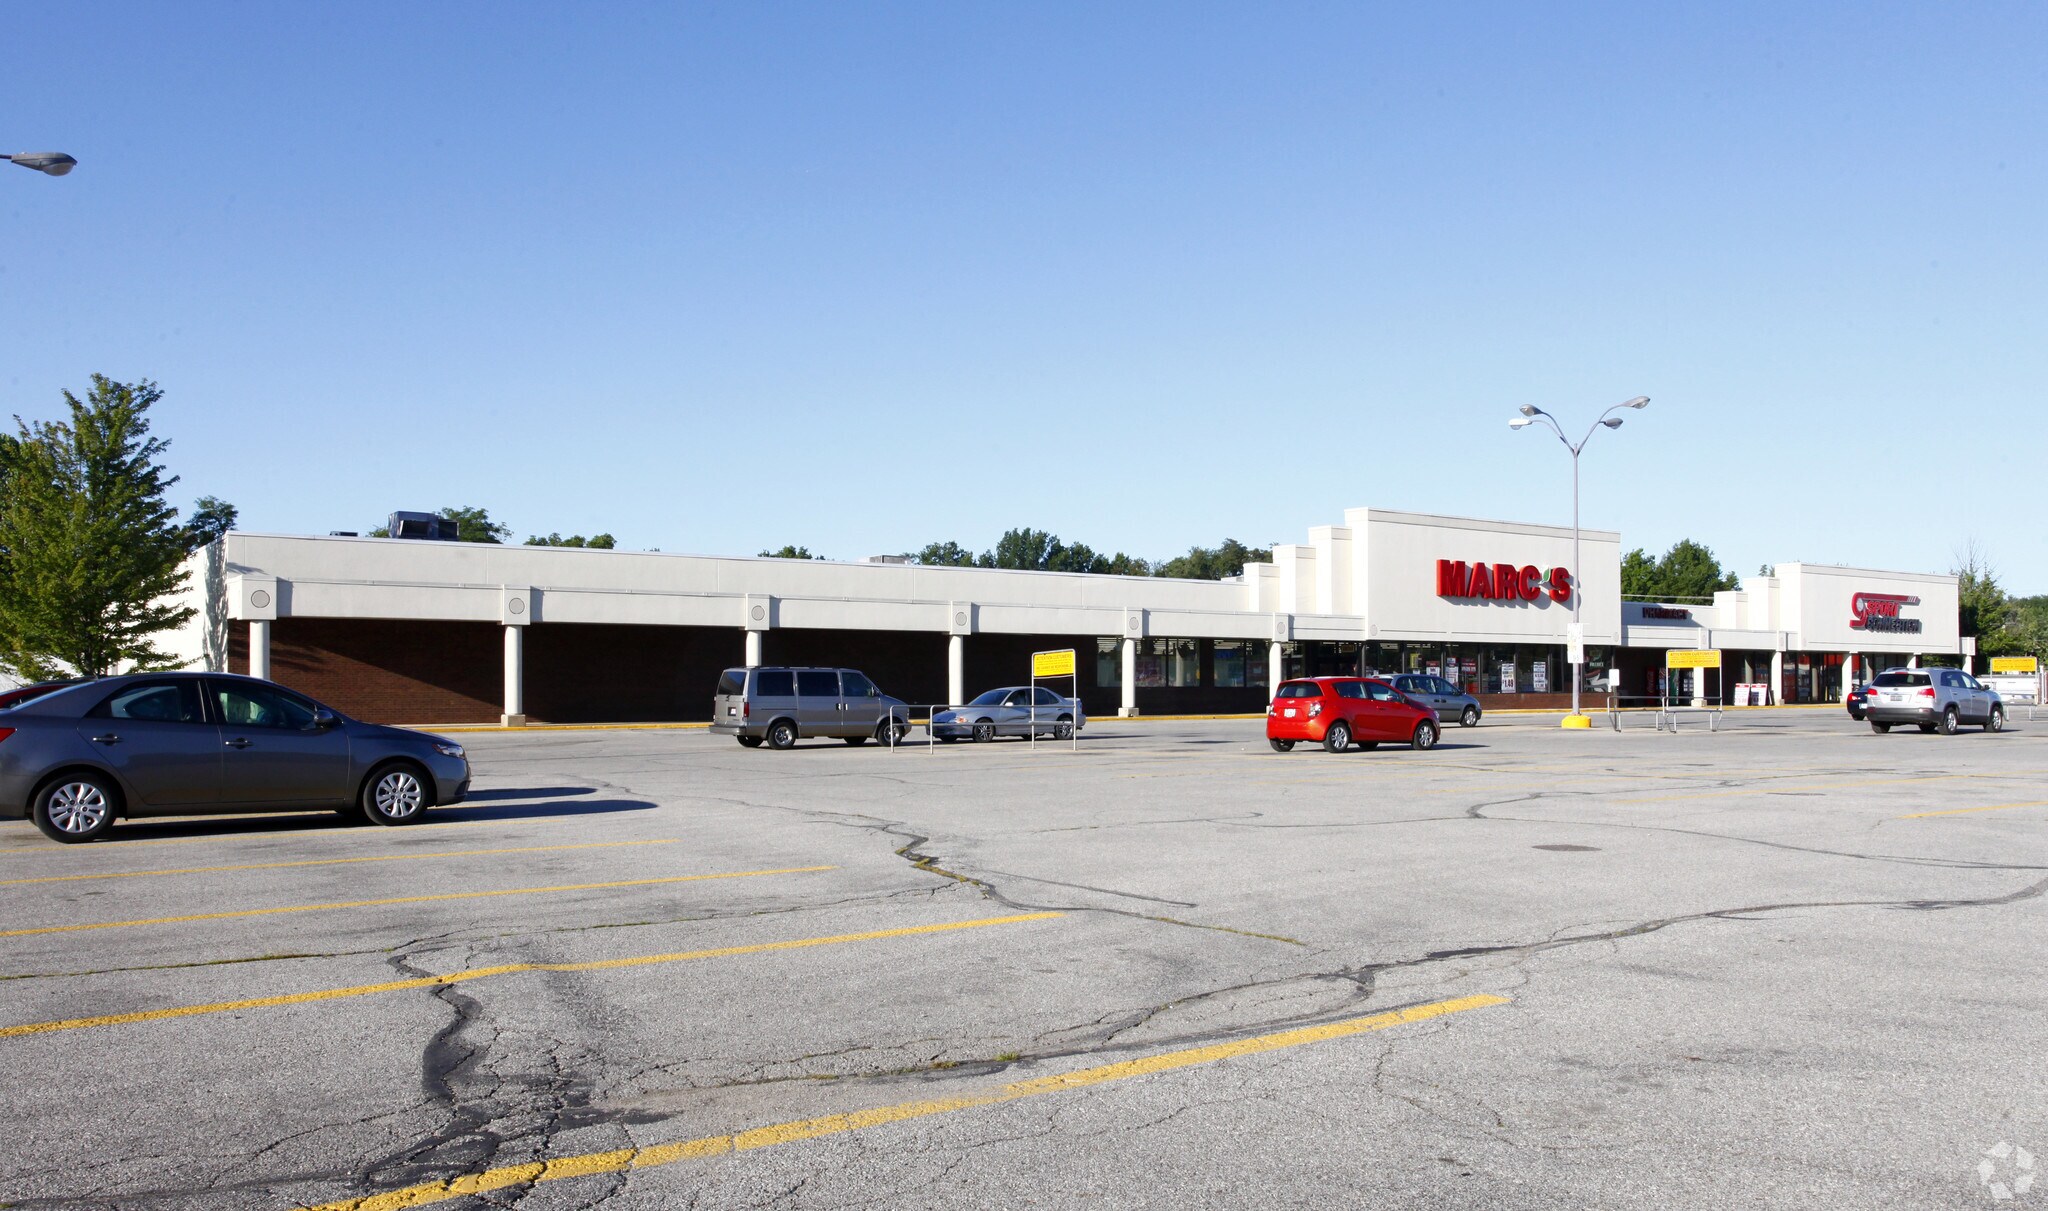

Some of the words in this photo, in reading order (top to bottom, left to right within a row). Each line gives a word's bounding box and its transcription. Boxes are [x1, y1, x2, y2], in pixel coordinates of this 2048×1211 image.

[1436, 558, 1571, 603] MARC'S
[1642, 606, 1688, 620] PHARMACY
[1866, 600, 1899, 617] SPORT
